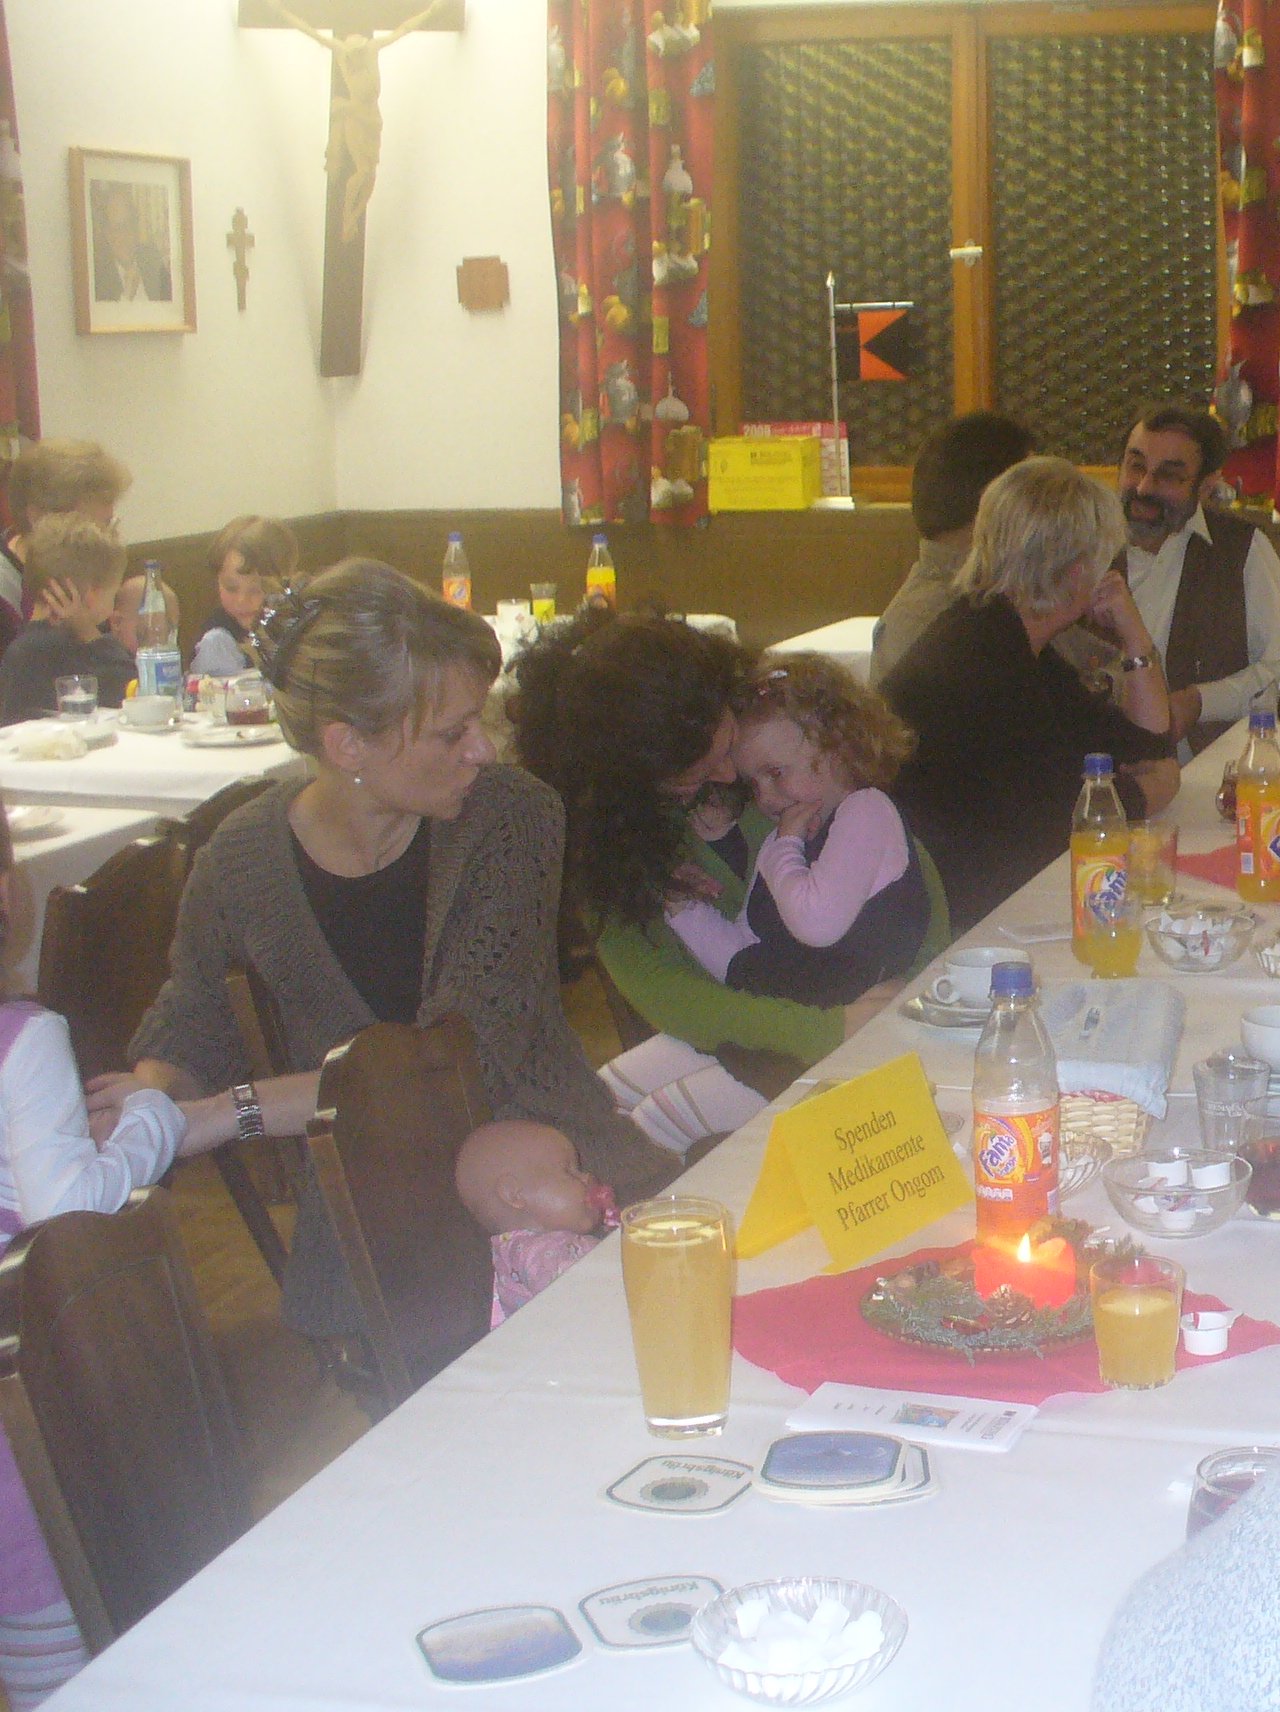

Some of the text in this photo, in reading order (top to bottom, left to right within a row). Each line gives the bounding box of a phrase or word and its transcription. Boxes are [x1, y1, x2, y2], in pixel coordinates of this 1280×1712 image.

[834, 1110, 897, 1154] Spenden
[979, 1133, 1015, 1177] Fanta
[828, 1134, 926, 1194] Medikamente
[836, 1189, 891, 1231] Pfarrer
[890, 1165, 946, 1202] Ongom
